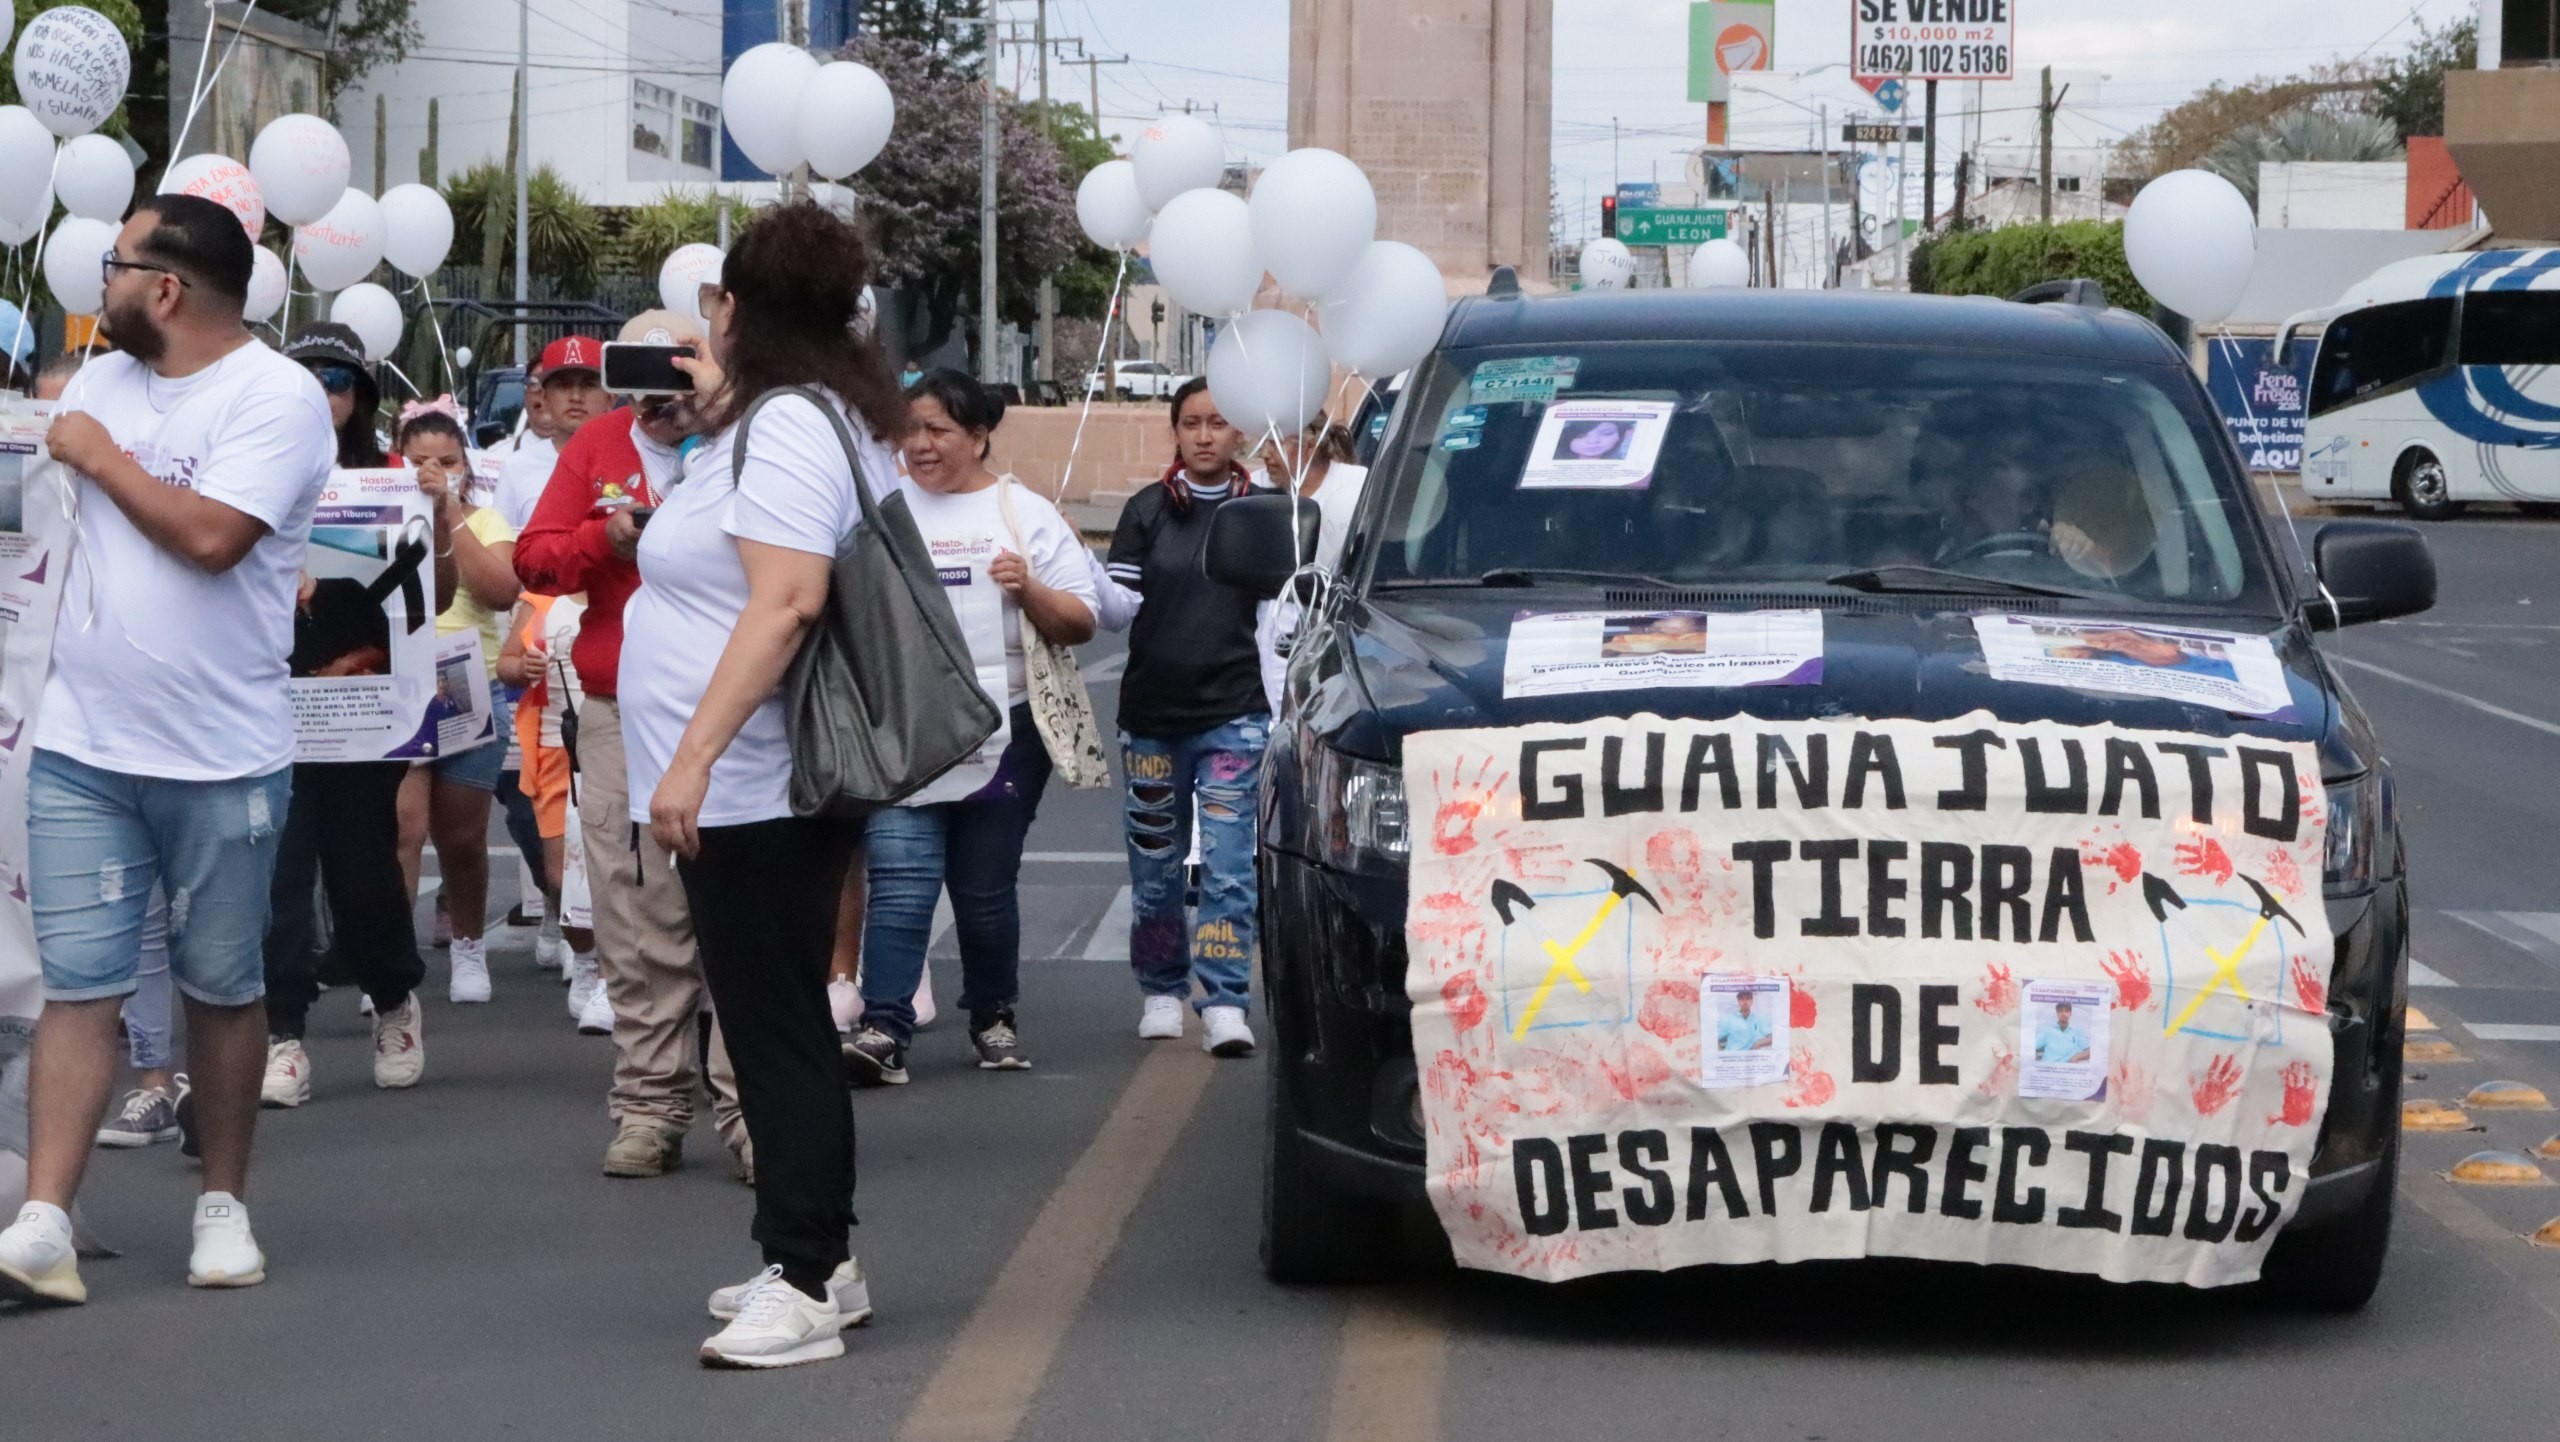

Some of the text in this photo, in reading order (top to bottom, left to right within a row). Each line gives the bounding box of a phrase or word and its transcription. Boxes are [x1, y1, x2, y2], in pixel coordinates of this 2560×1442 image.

[1860, 0, 2007, 23] SE VENDE
[1874, 26, 1994, 42] $10,000 m2
[1860, 44, 2007, 73] (462) 102 5136
[1856, 127, 1876, 139] 624
[1880, 127, 1894, 139] 22
[1654, 214, 1724, 226] GUANAJUATO
[1667, 229, 1711, 240] LEON
[563, 338, 583, 364] A
[2259, 371, 2297, 388] Feria
[2254, 384, 2300, 403] Fresas
[2226, 417, 2268, 428] PUNTO
[2271, 418, 2288, 428] DE
[2250, 449, 2300, 469] AQU
[360, 476, 395, 485] Hasta
[342, 510, 377, 518] Tiburcio
[1549, 663, 1601, 672] colonia
[1604, 660, 1650, 668] Nuevo
[1518, 730, 2300, 843] GUANAJUATO
[1732, 838, 2095, 942] TIERRA
[1851, 983, 1960, 1086] DE
[1512, 1120, 2291, 1245] DESAPARECIDOS
